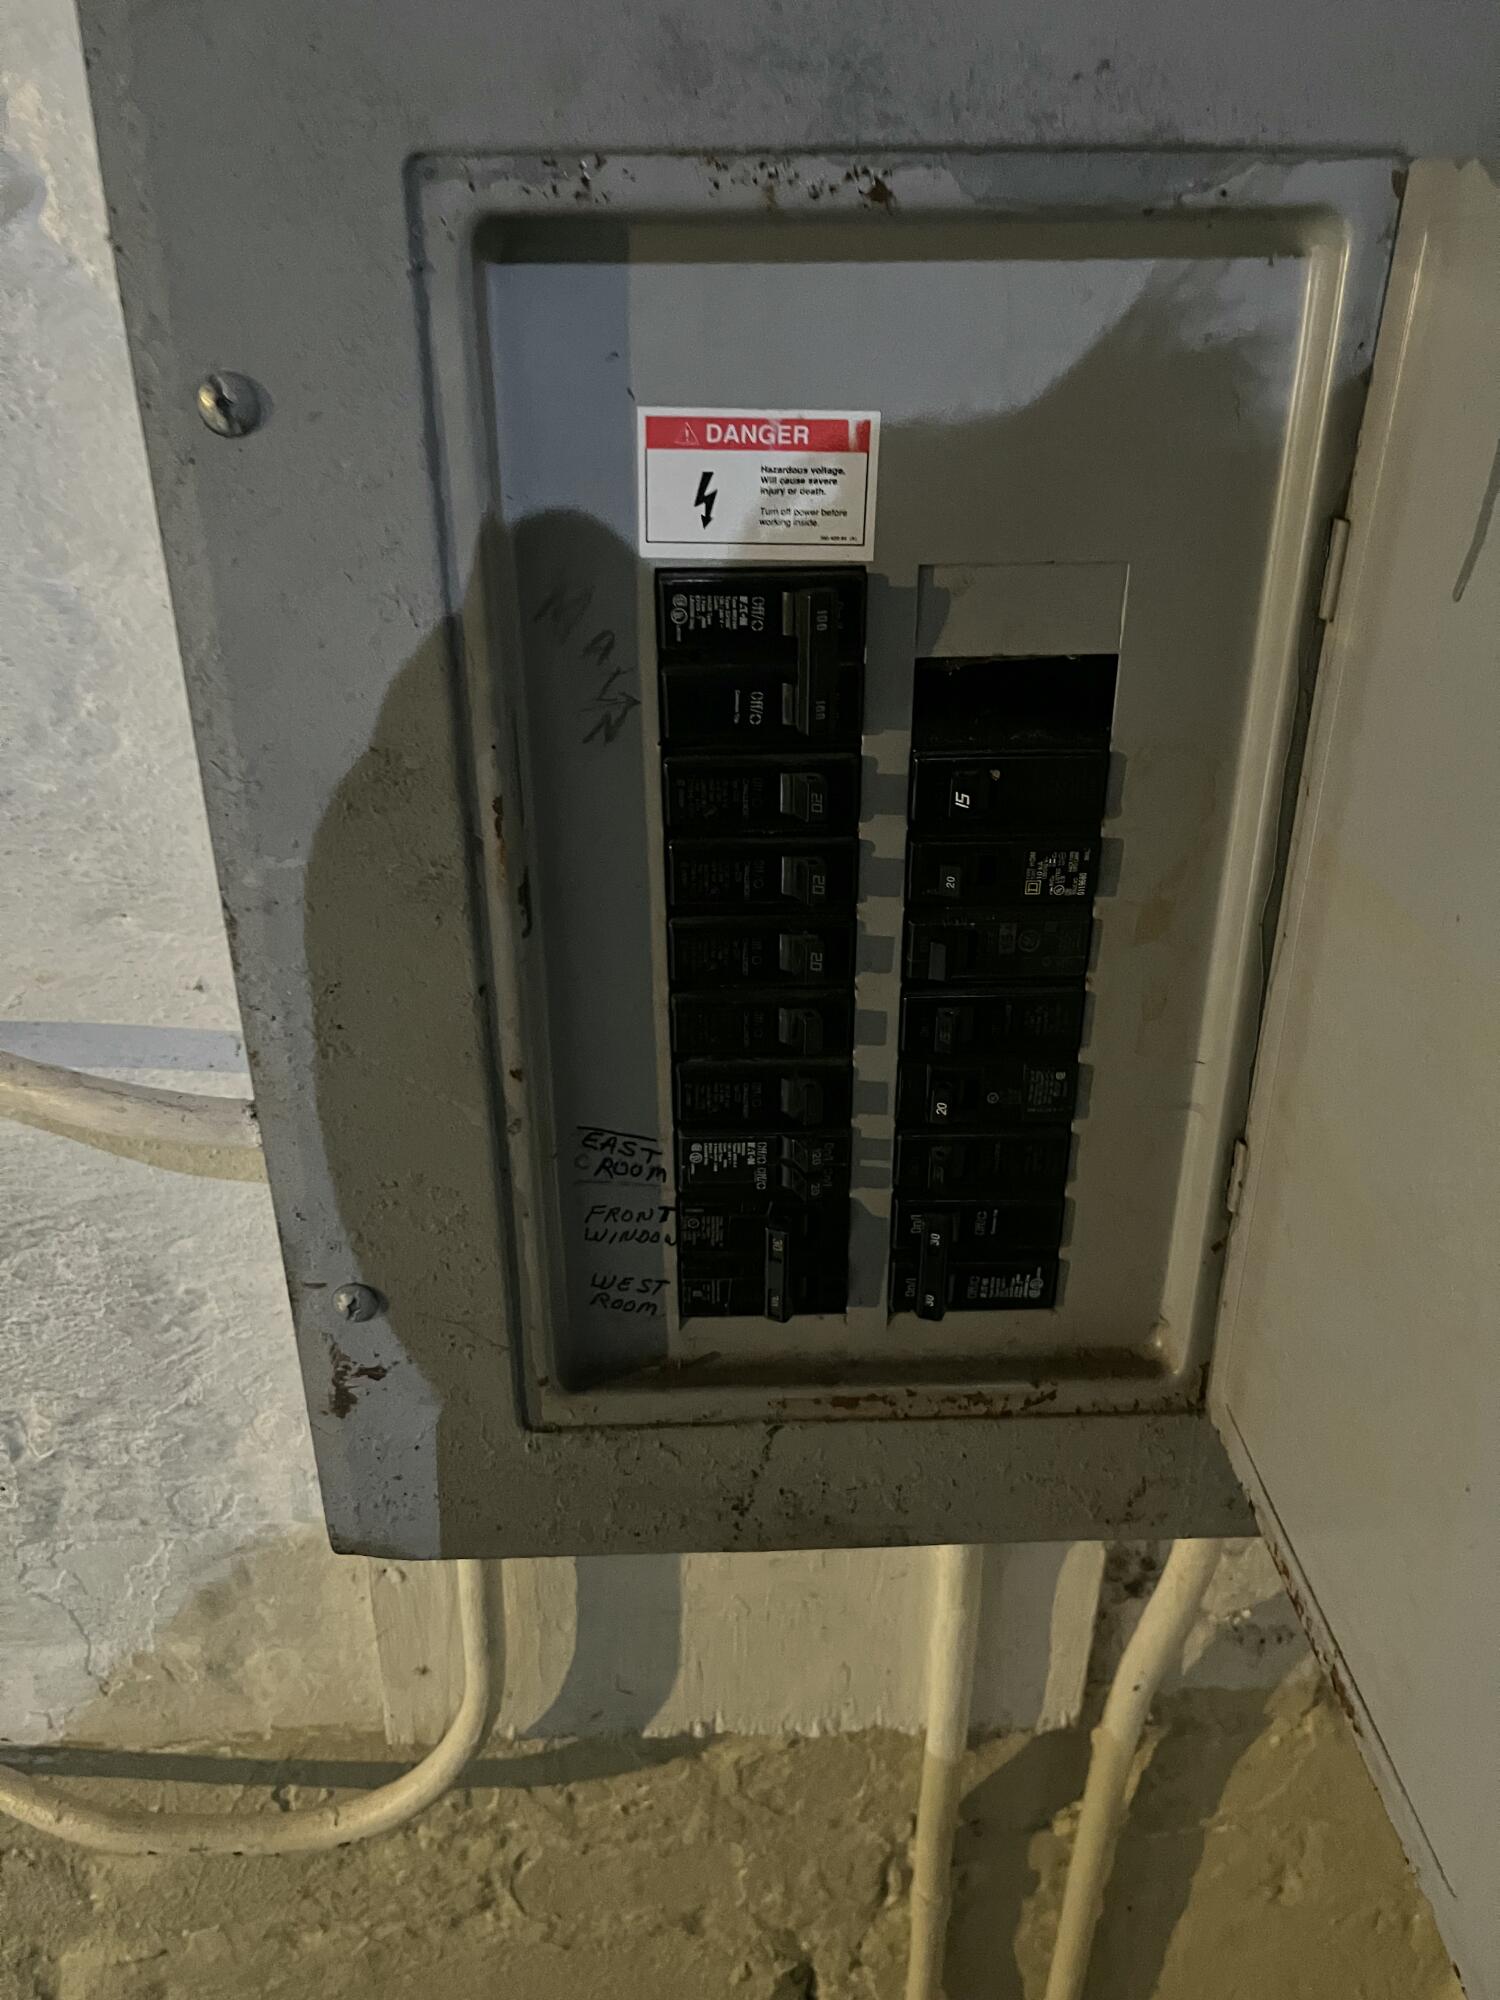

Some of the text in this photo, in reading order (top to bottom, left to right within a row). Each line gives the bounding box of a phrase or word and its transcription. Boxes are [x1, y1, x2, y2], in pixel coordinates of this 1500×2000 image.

[706, 424, 809, 445] DANGER
[760, 464, 846, 476] Hazardous voltage.
[760, 476, 838, 486] Will cause severe
[760, 487, 827, 497] injury or death.
[760, 507, 848, 519] Turn off power before
[759, 519, 792, 528] working
[955, 791, 970, 809] 15
[946, 875, 956, 889] 20
[810, 952, 823, 972] 20
[936, 1102, 948, 1116] 20
[582, 1132, 663, 1164] EAST
[593, 1157, 667, 1183] ROOM
[585, 1205, 678, 1224] FRONT
[929, 1232, 941, 1246] 30
[590, 1272, 671, 1296] WEST
[589, 1292, 658, 1317] ROOM
